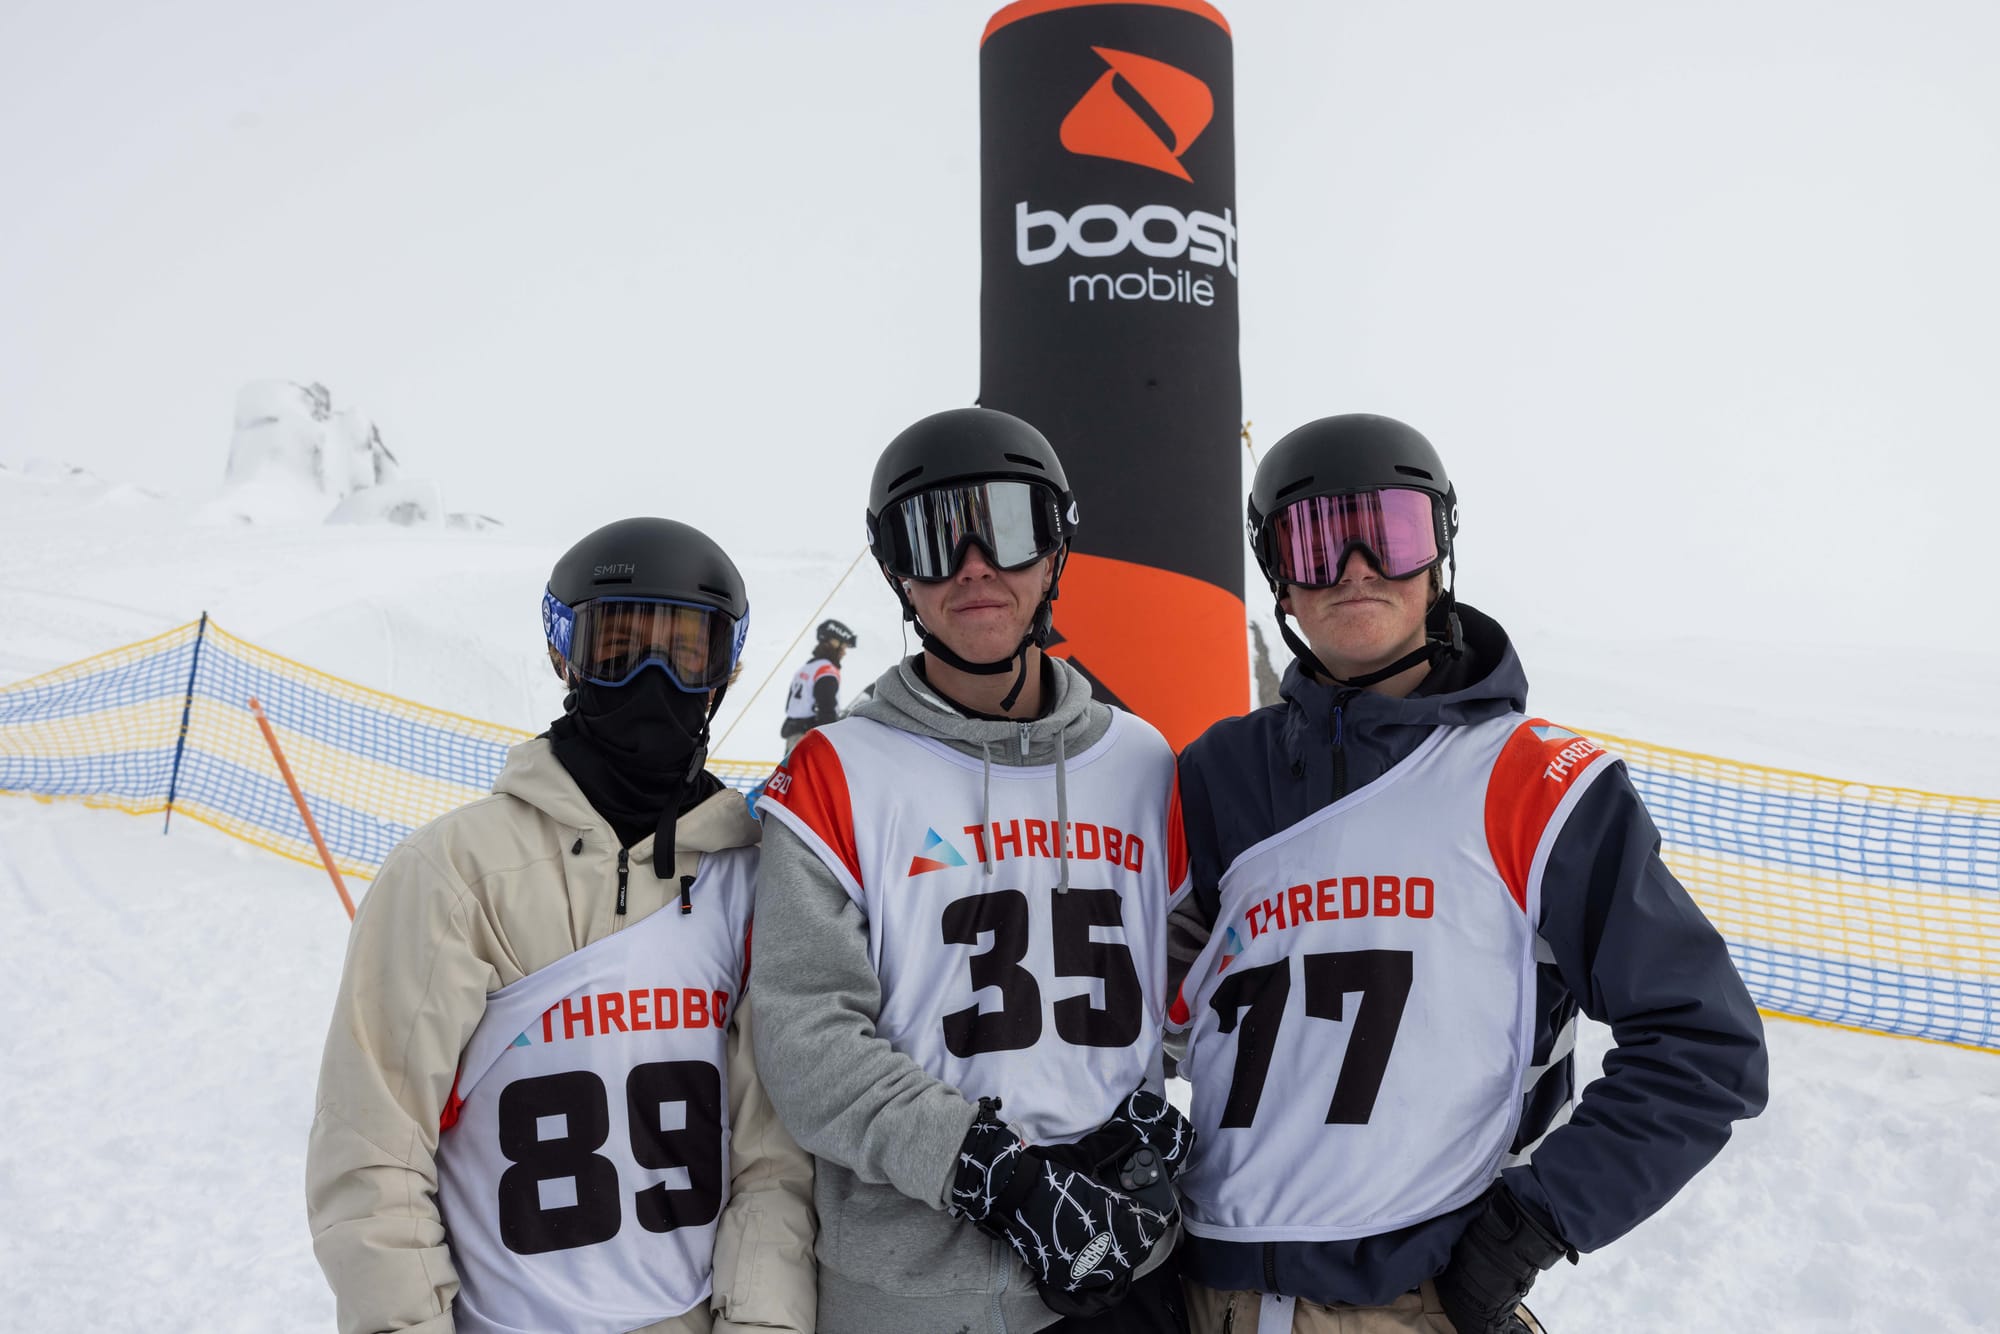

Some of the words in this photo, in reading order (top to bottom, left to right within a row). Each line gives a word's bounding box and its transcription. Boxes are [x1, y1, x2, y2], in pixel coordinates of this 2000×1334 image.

[1016, 201, 1237, 278] boost
[1069, 267, 1214, 306] mobile
[594, 563, 635, 576] SMITH
[1543, 740, 1600, 783] THRED
[963, 818, 1144, 874] THREDBO
[1245, 875, 1434, 940] THREDBO
[941, 888, 1142, 1058] 35
[541, 988, 729, 1043] THREDBO
[1209, 949, 1413, 1128] 77
[498, 1060, 722, 1255] 89
